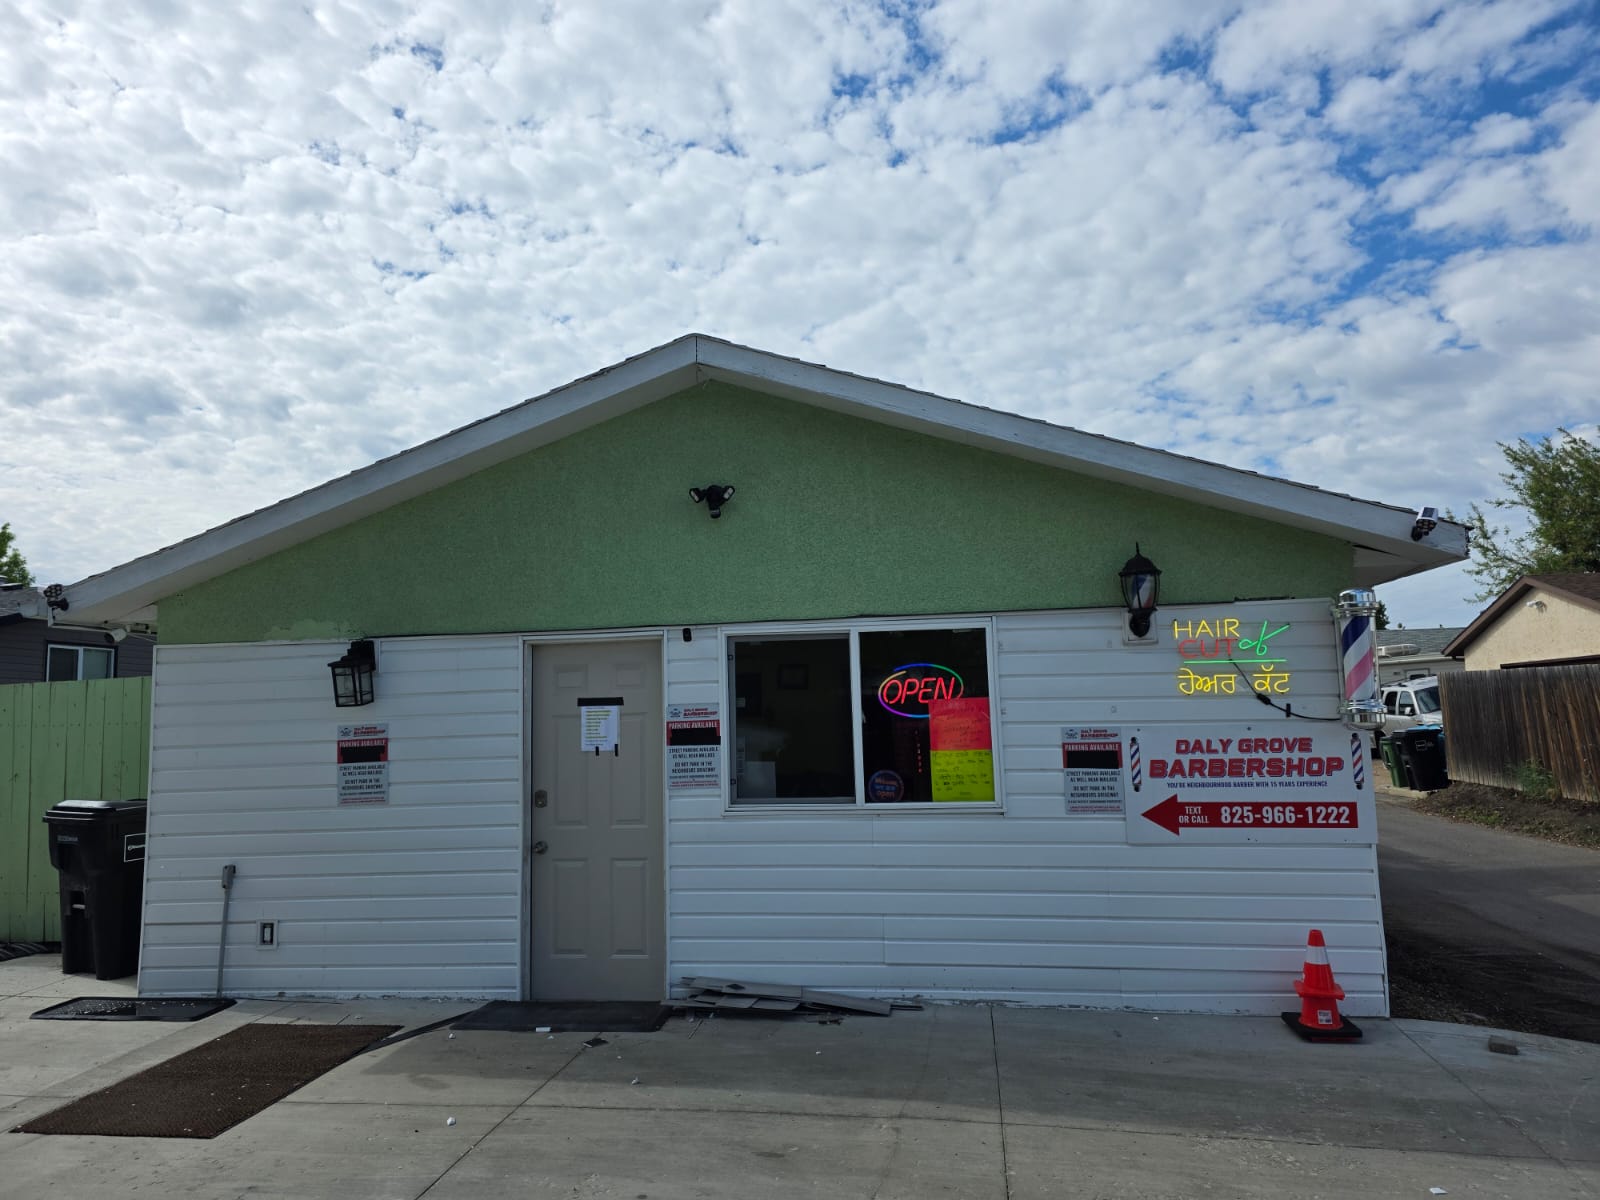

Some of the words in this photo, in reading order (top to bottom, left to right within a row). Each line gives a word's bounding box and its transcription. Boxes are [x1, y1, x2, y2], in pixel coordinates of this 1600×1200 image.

[1173, 618, 1240, 639] HAIR
[1178, 638, 1236, 659] CUT
[1252, 663, 1292, 693] ਕੱਟ
[882, 676, 957, 704] OPEN
[1175, 738, 1233, 754] DALY
[1237, 737, 1313, 753] GROVE
[1149, 756, 1345, 779] BARBERSHOP
[1178, 815, 1190, 824] OR
[1191, 815, 1210, 824] CALL
[1184, 806, 1202, 815] TEXT
[1220, 806, 1350, 824] 825-966-1222
